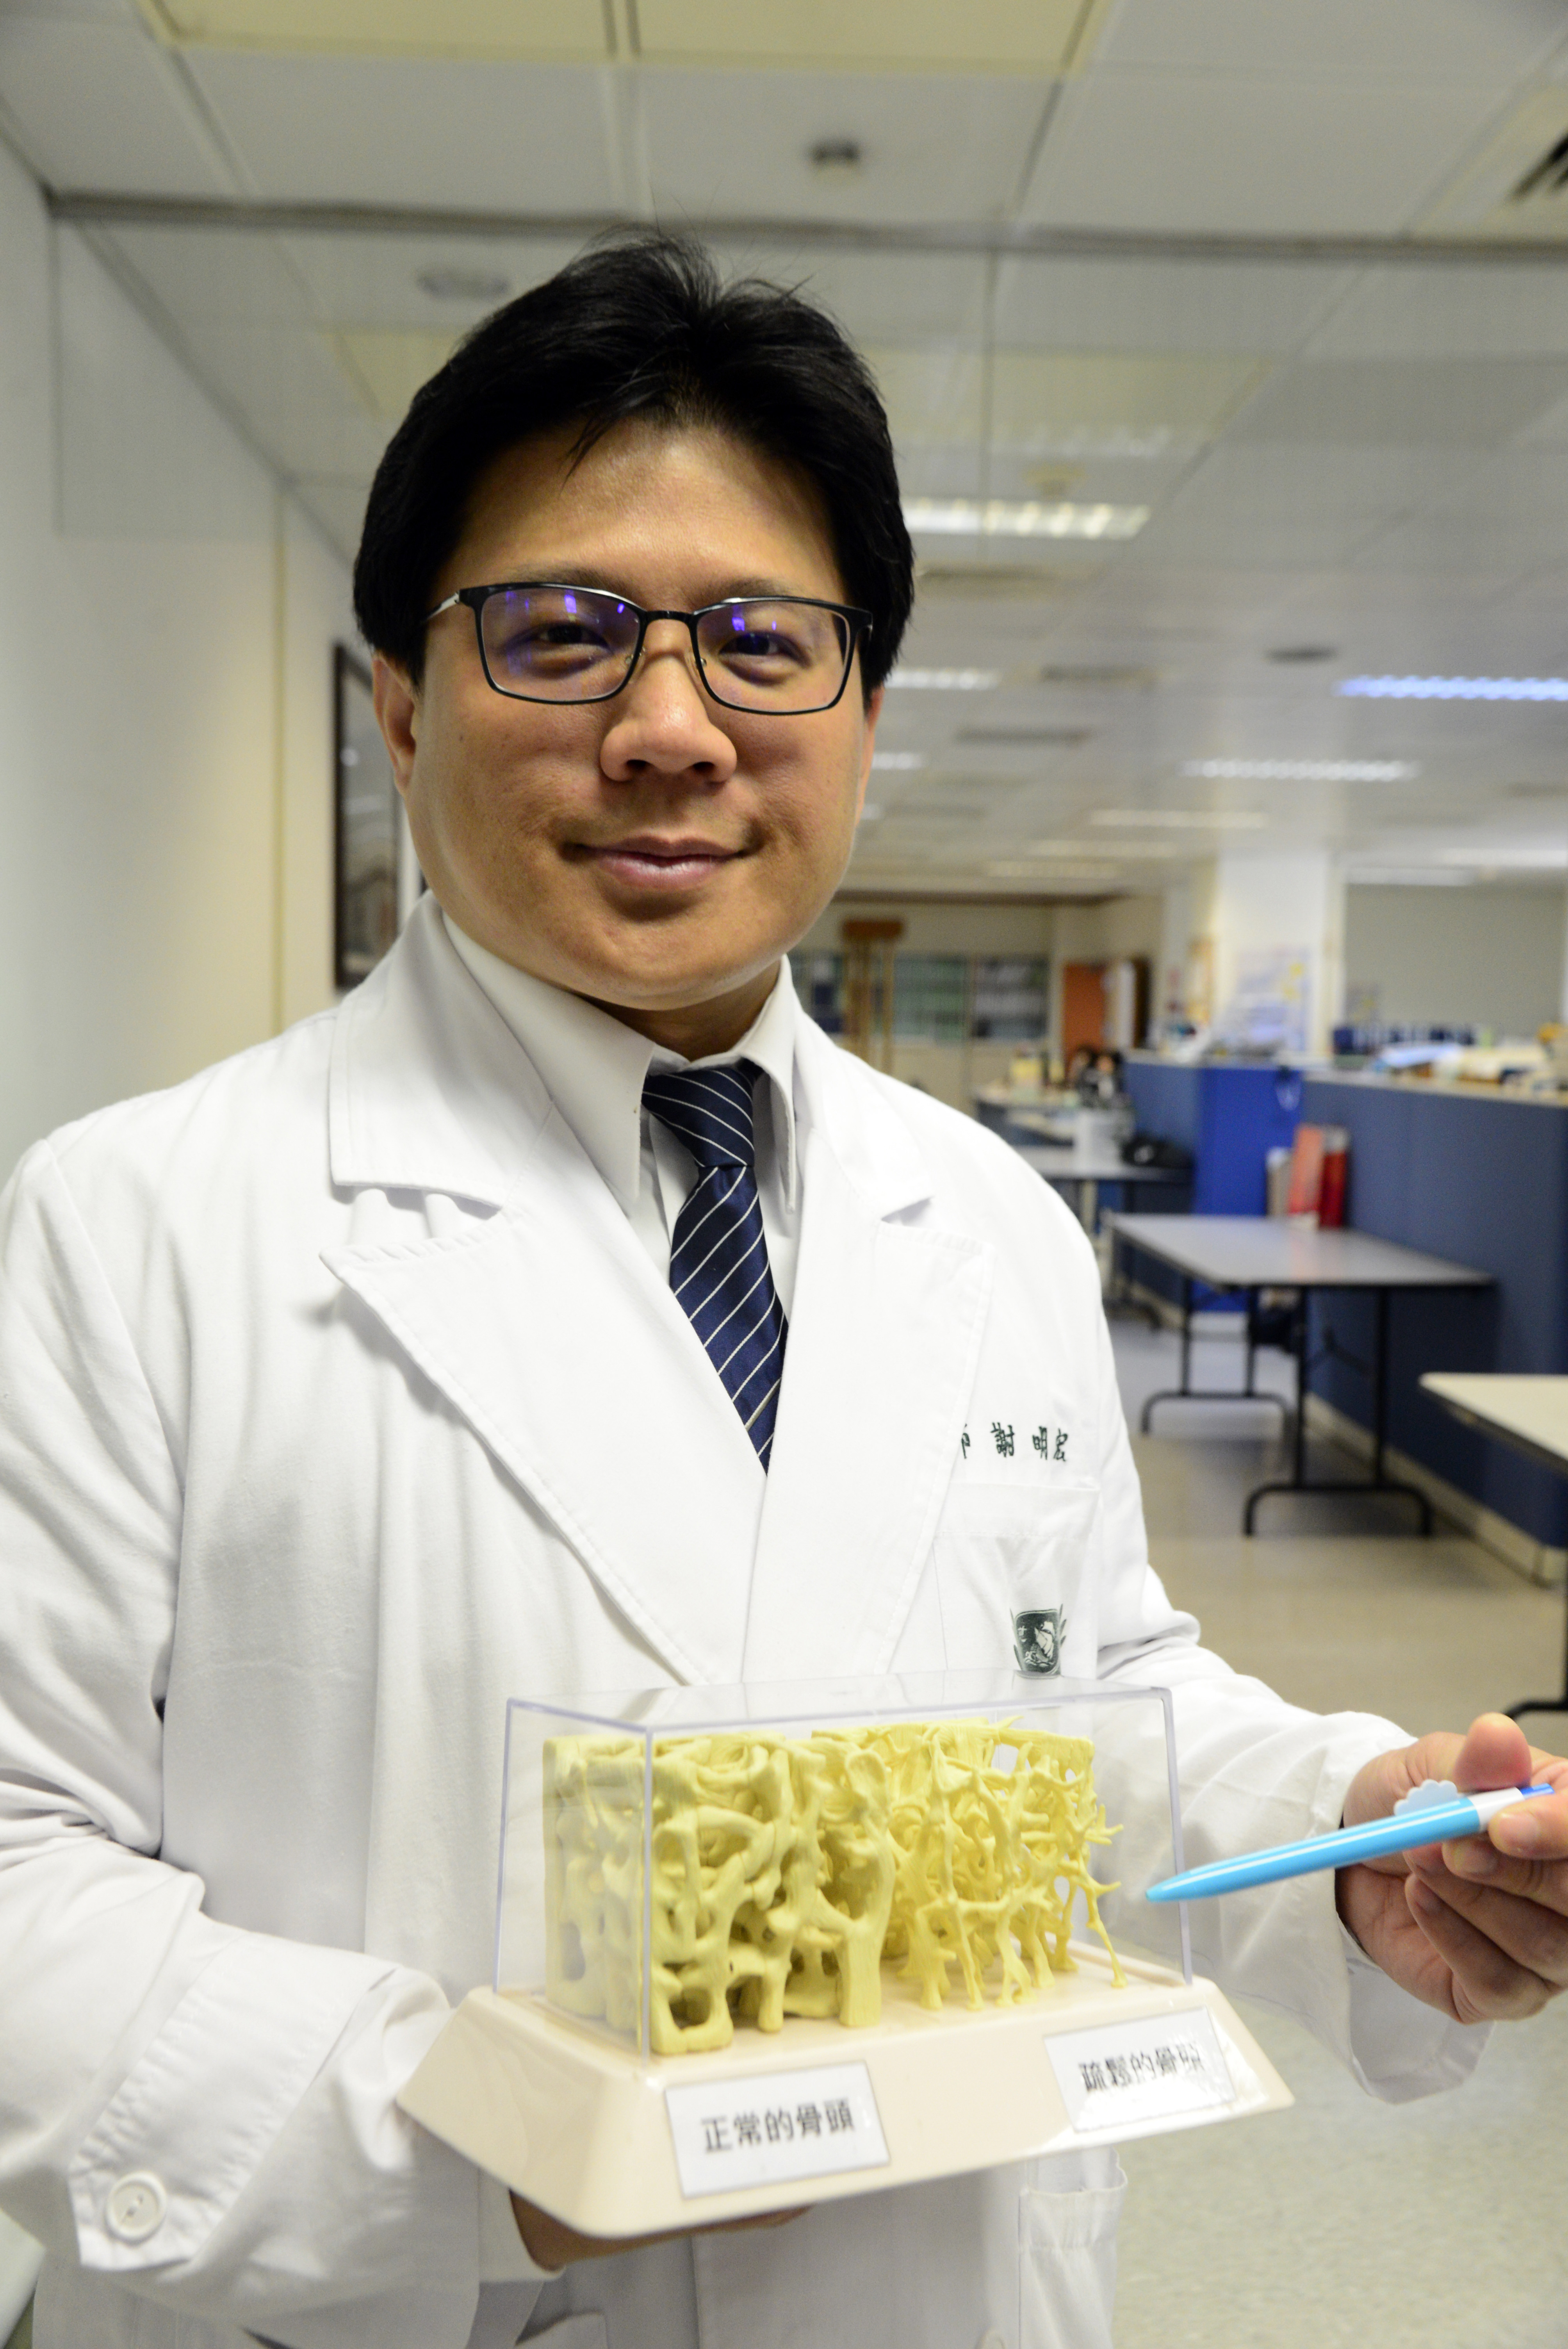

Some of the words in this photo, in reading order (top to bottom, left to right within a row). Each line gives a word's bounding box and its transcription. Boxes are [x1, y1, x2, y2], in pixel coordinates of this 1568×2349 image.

[702, 2097, 854, 2153] 正常的骨頭
